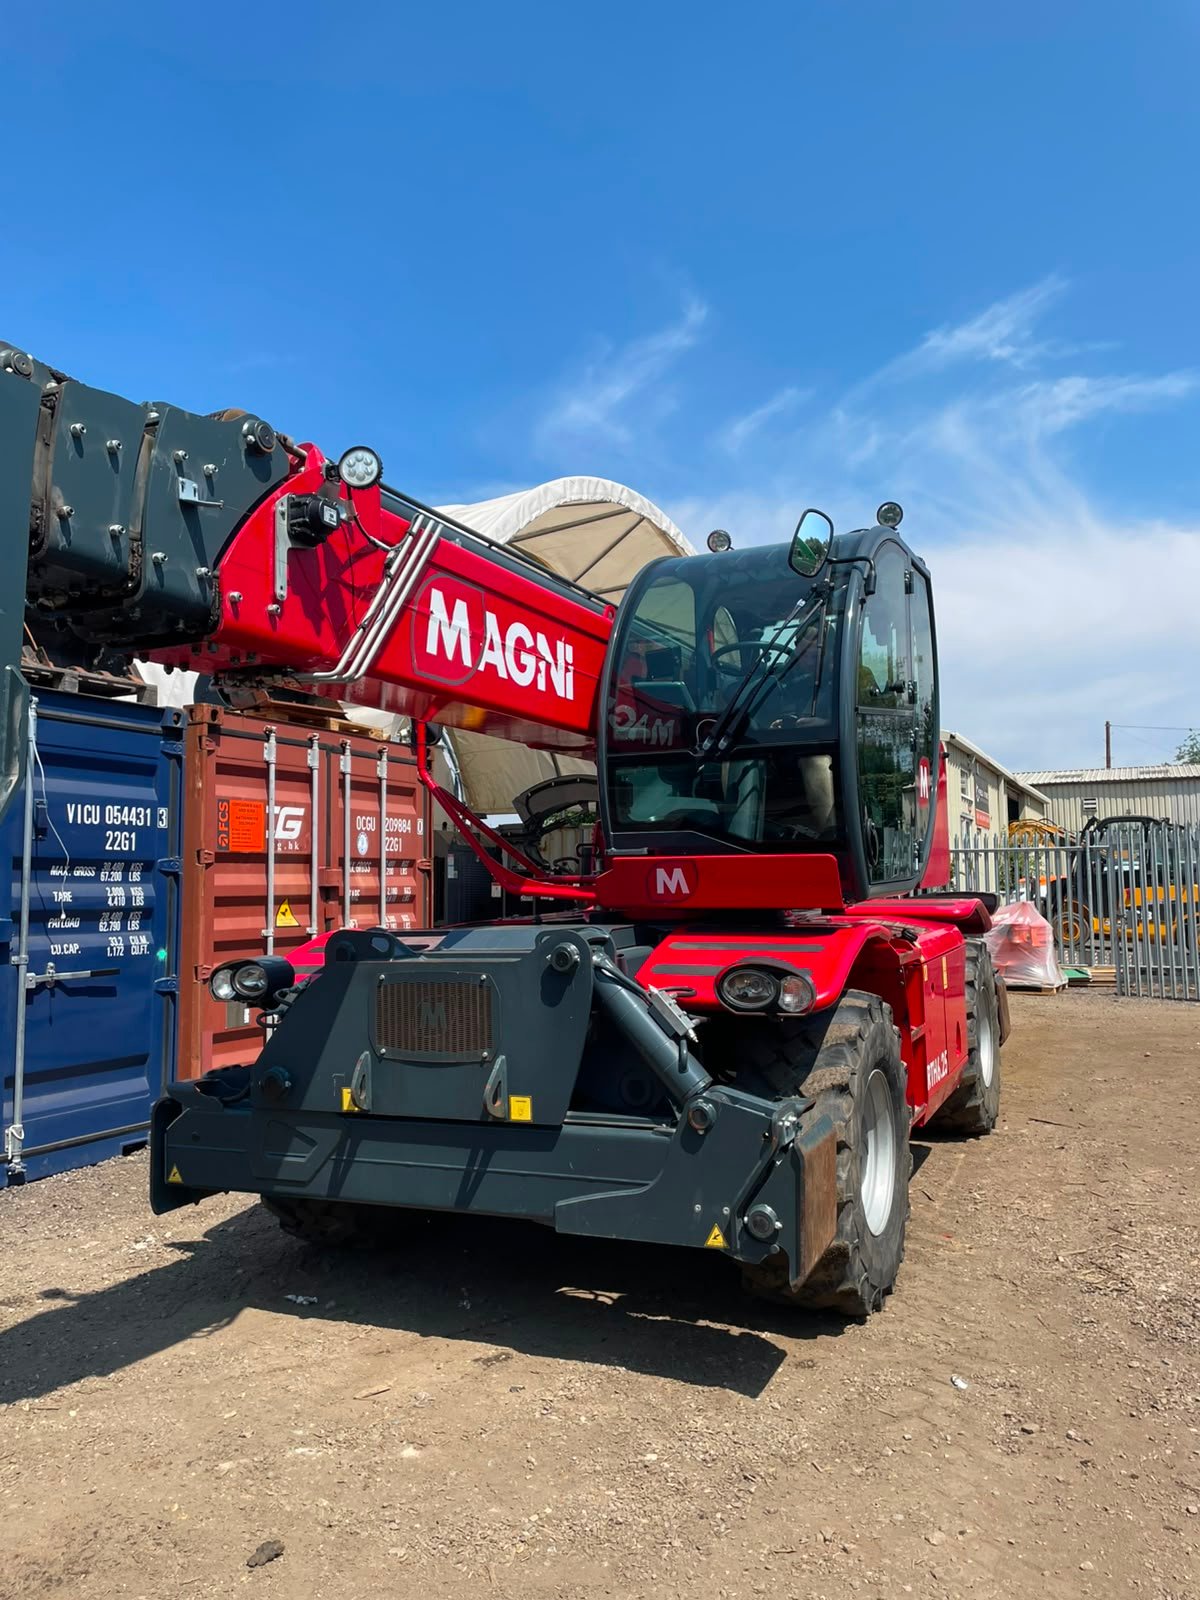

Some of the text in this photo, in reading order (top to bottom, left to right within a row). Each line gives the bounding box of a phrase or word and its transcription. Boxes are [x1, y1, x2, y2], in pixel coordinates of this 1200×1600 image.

[425, 587, 574, 700] MAGNI
[66, 803, 168, 828] VICU 054431 3
[218, 801, 229, 832] FCS
[356, 815, 376, 831] OCGU
[385, 817, 412, 834] 209884
[105, 830, 136, 851] 22G1
[385, 836, 402, 852] 22G1
[50, 865, 71, 877] MAX.
[73, 866, 97, 877] GROSS
[100, 871, 141, 882] 67.200 LBS
[655, 867, 690, 894] M
[52, 891, 73, 903] TARE
[130, 886, 144, 897] KGS
[107, 896, 145, 906] 4.410 LBS
[47, 917, 81, 929] PAYLOAD
[99, 920, 140, 932] 62.790 LBS
[50, 943, 81, 955] CU.CAP.
[108, 936, 124, 946] 33.2
[107, 946, 124, 957] 1.172
